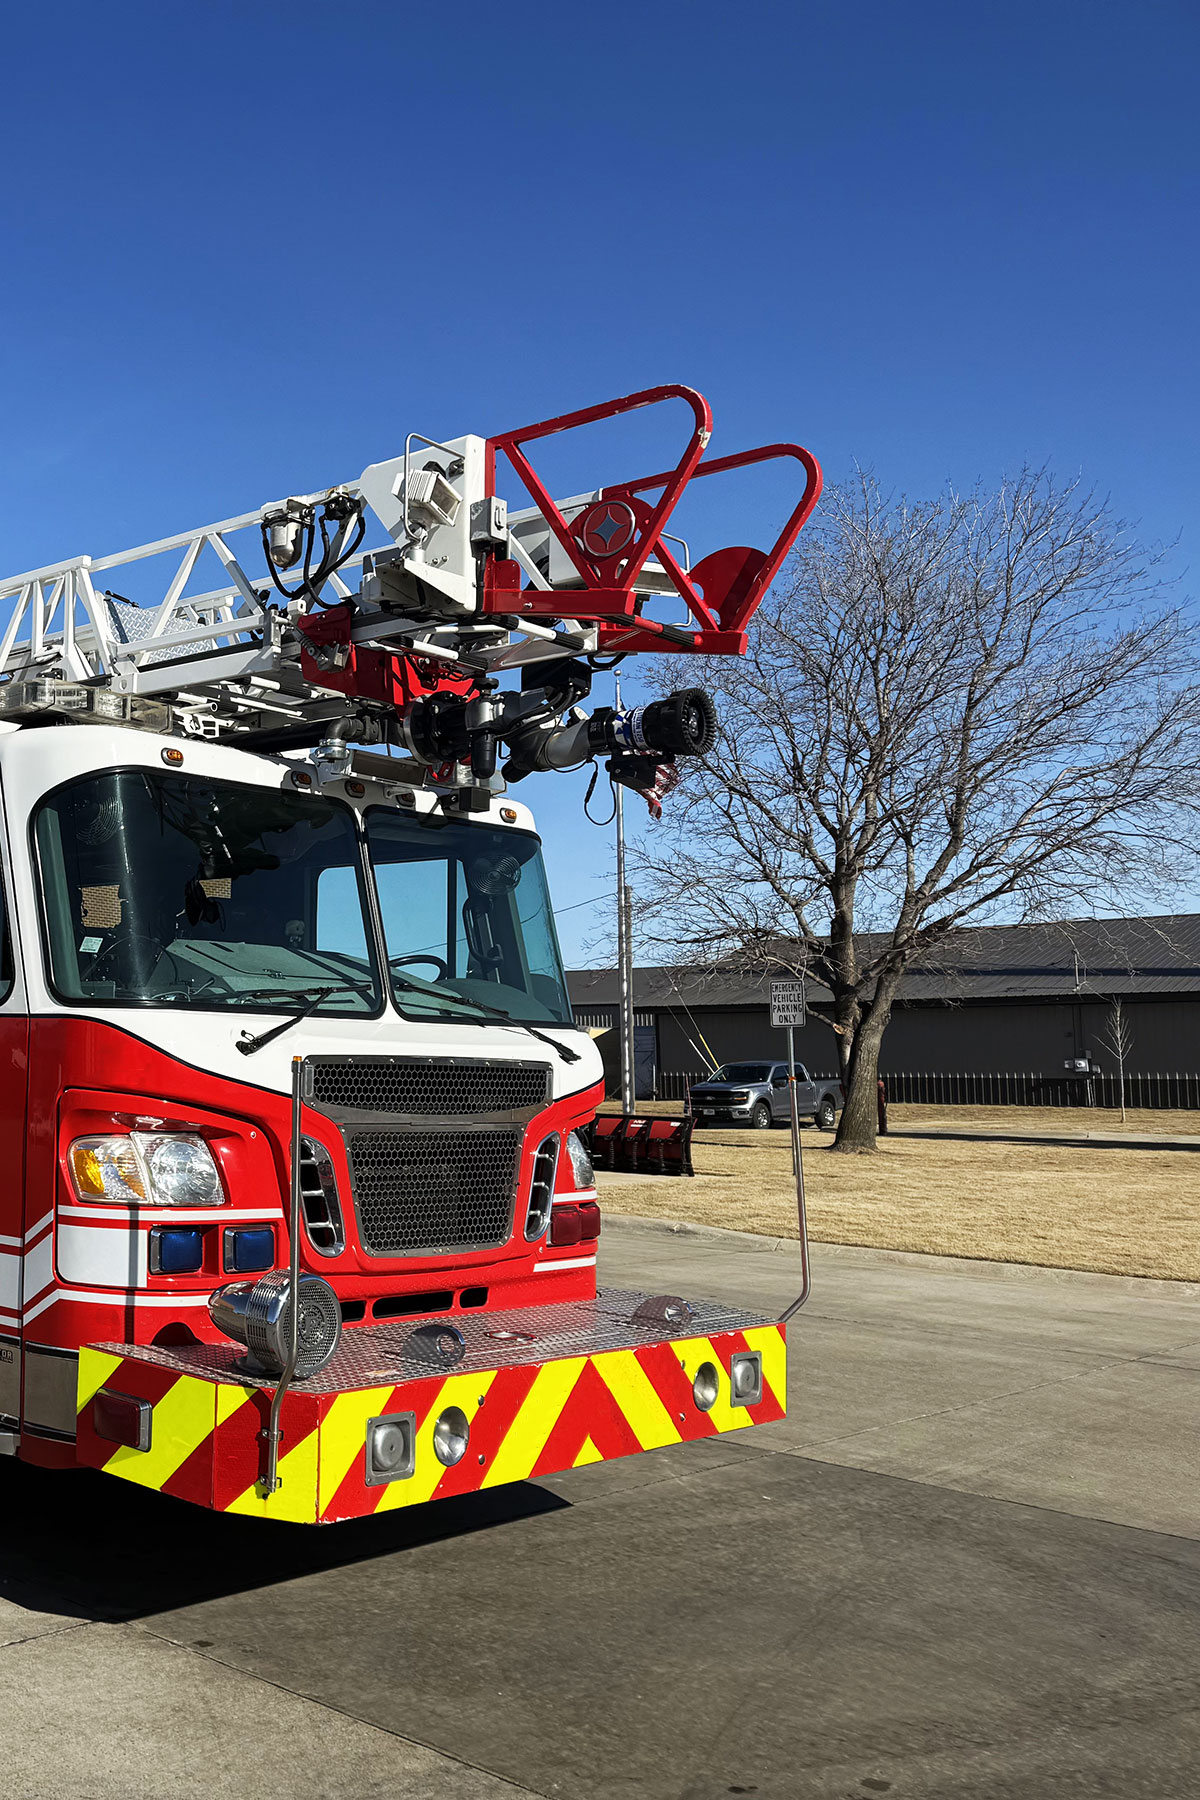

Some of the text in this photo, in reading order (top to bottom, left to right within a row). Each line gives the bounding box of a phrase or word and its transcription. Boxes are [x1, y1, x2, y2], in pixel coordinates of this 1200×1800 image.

[772, 983, 801, 993] EMERGENCY
[772, 993, 802, 1003] VEHICLE
[772, 1004, 803, 1013] PARKING
[778, 1014, 797, 1024] ONLY
